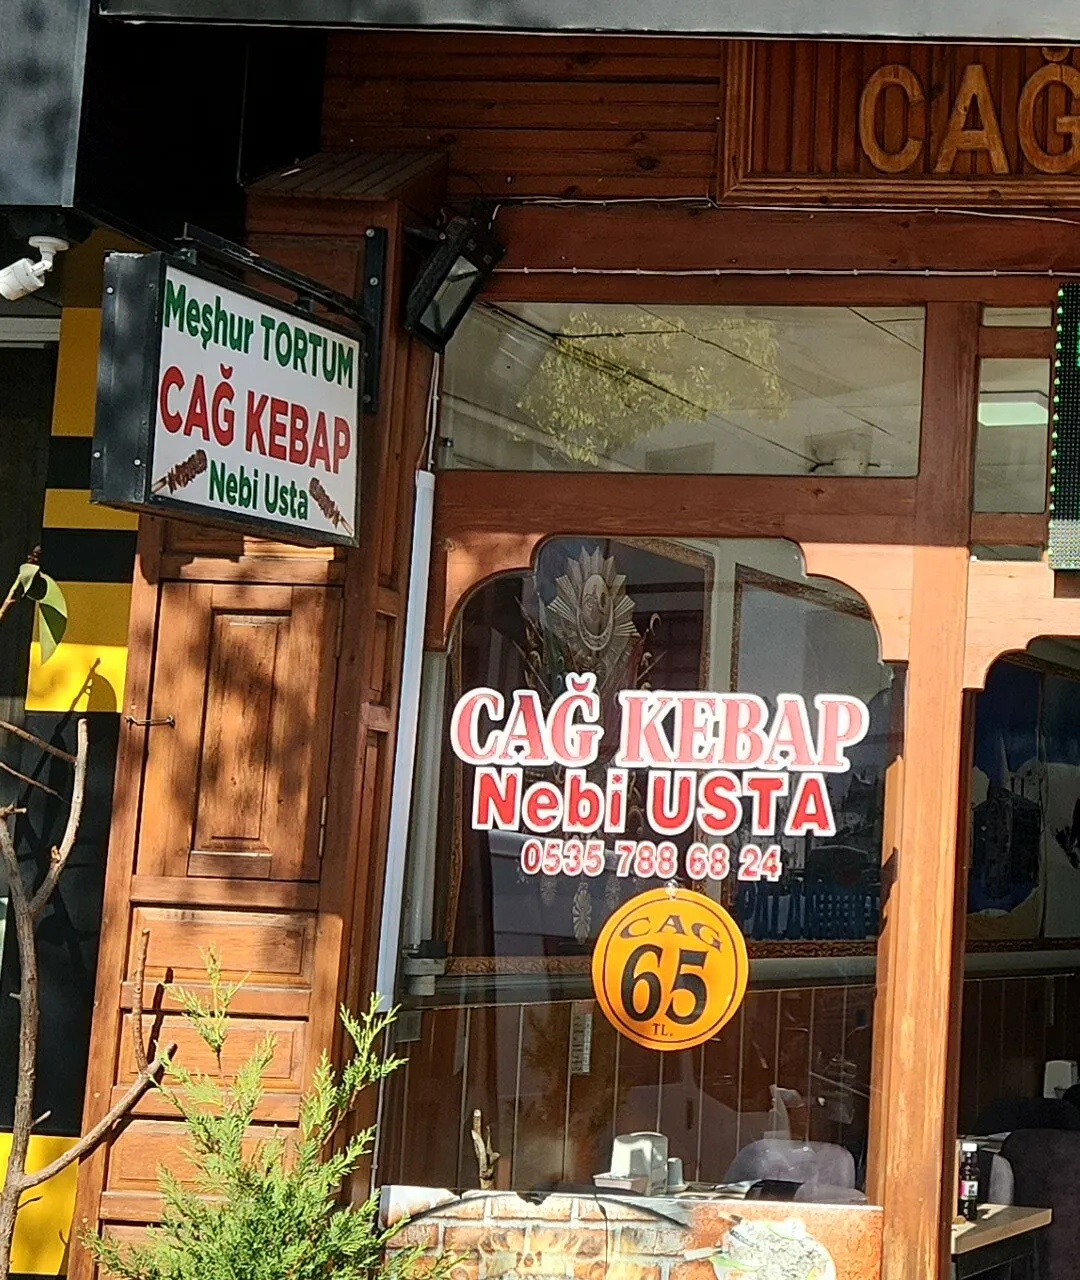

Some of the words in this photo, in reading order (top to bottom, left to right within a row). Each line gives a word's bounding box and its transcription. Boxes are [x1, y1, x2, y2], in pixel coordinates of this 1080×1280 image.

[164, 278, 254, 353] Meşhur
[260, 314, 355, 389] TORTUM
[159, 363, 236, 447] CAĞ
[245, 390, 351, 474] KEBAP
[208, 460, 259, 510] Nebi
[264, 476, 309, 520] Usta
[453, 675, 602, 765] CAĞ
[617, 692, 868, 771] KEBAP
[473, 768, 627, 832] Nebi
[647, 771, 835, 835] USTA
[521, 839, 605, 876] 0535
[615, 843, 678, 878] 788
[686, 844, 730, 880] 68
[738, 846, 782, 881] 24
[620, 943, 709, 1025] 65
